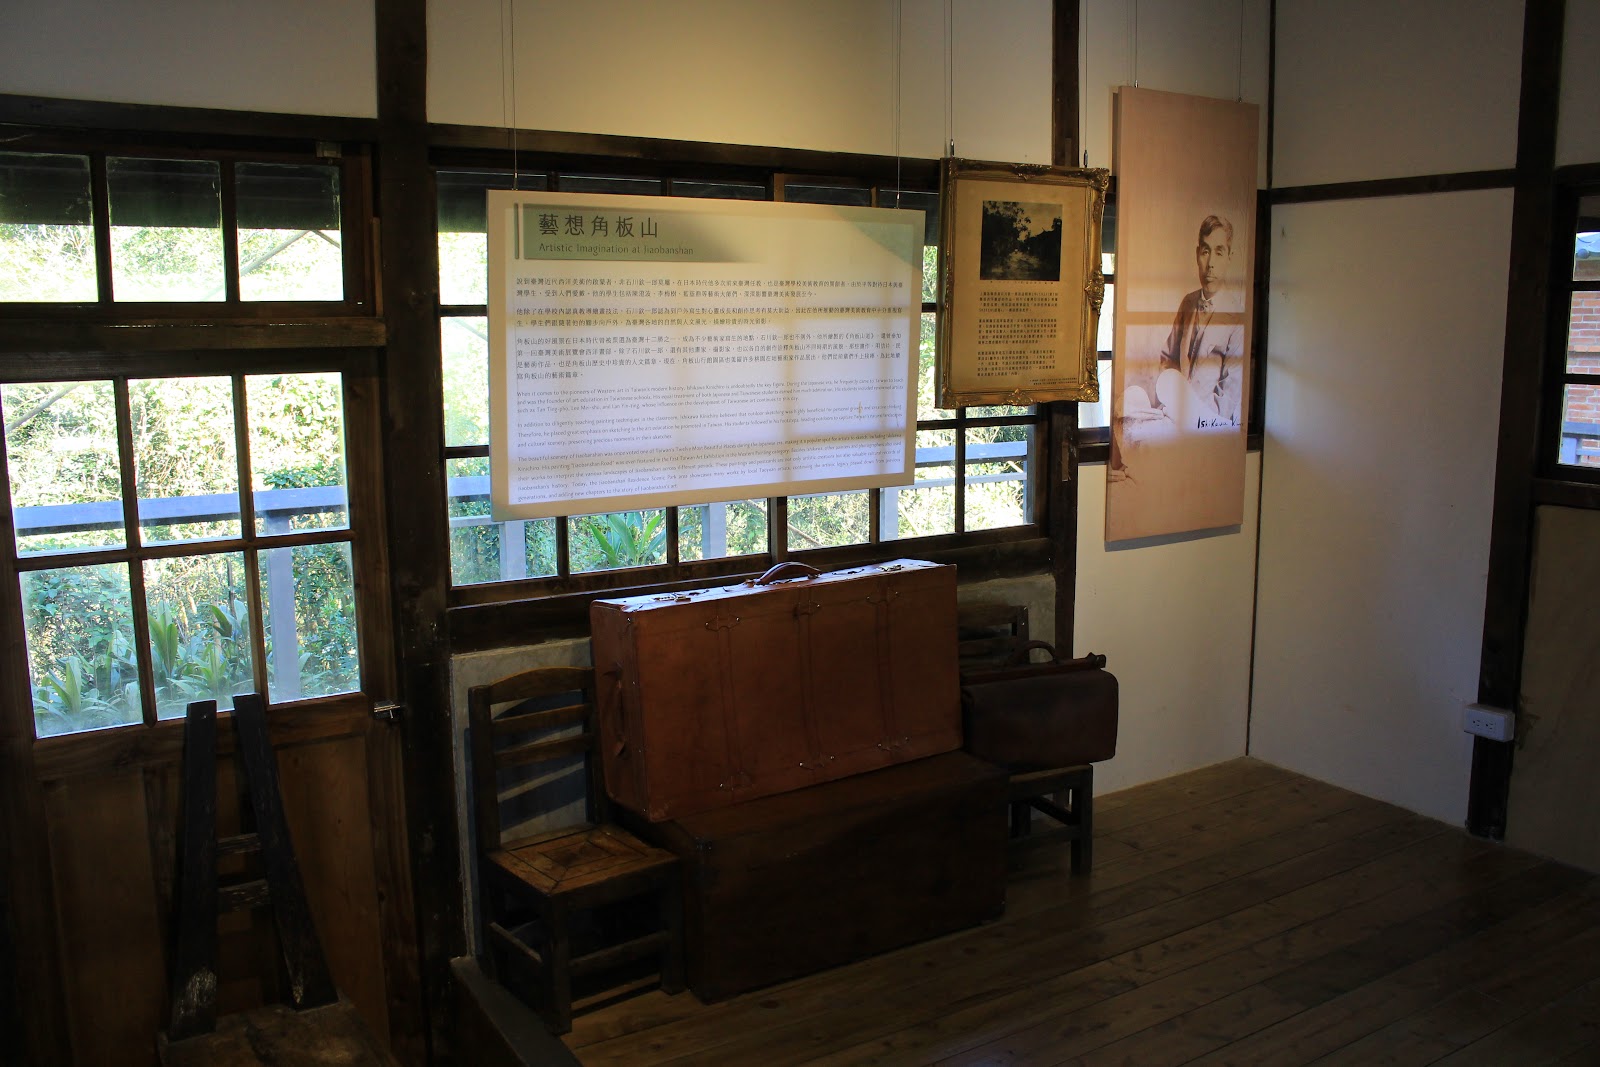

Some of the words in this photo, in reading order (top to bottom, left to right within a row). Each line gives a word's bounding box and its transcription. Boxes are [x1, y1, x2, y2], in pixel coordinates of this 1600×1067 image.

[538, 213, 658, 238] 藝想角板山
[538, 243, 573, 253] Artistic
[576, 243, 629, 256] Imagination
[632, 245, 641, 254] at
[643, 245, 694, 255] Jiaobanshan
